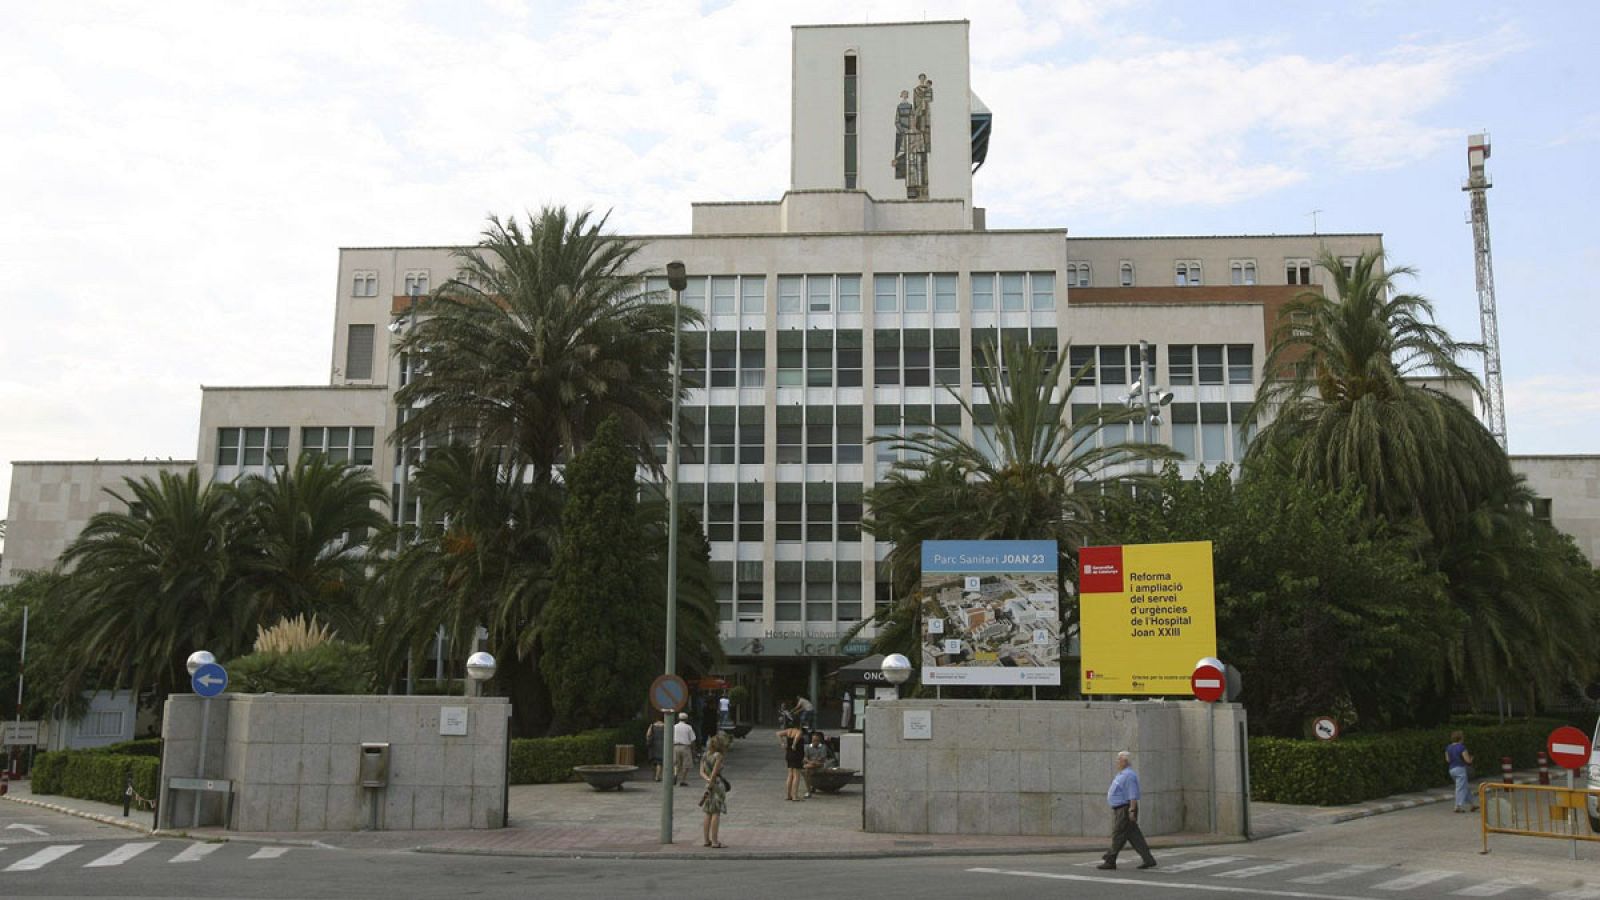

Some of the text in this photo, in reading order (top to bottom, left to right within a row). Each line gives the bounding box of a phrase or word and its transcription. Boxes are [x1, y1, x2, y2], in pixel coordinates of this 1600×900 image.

[934, 554, 1045, 564] Parc Sanitari JOAN 23
[1130, 572, 1171, 581] Reforma
[1135, 582, 1183, 593] ampliació
[1130, 594, 1177, 603] del servei
[1130, 605, 1188, 616] d'urgències
[1130, 616, 1191, 626] de l'Hospital
[765, 630, 802, 640] Hospital
[1038, 631, 1045, 640] A
[1131, 628, 1180, 637] Joan XXIII
[950, 641, 957, 649] B
[863, 671, 885, 680] ONC
